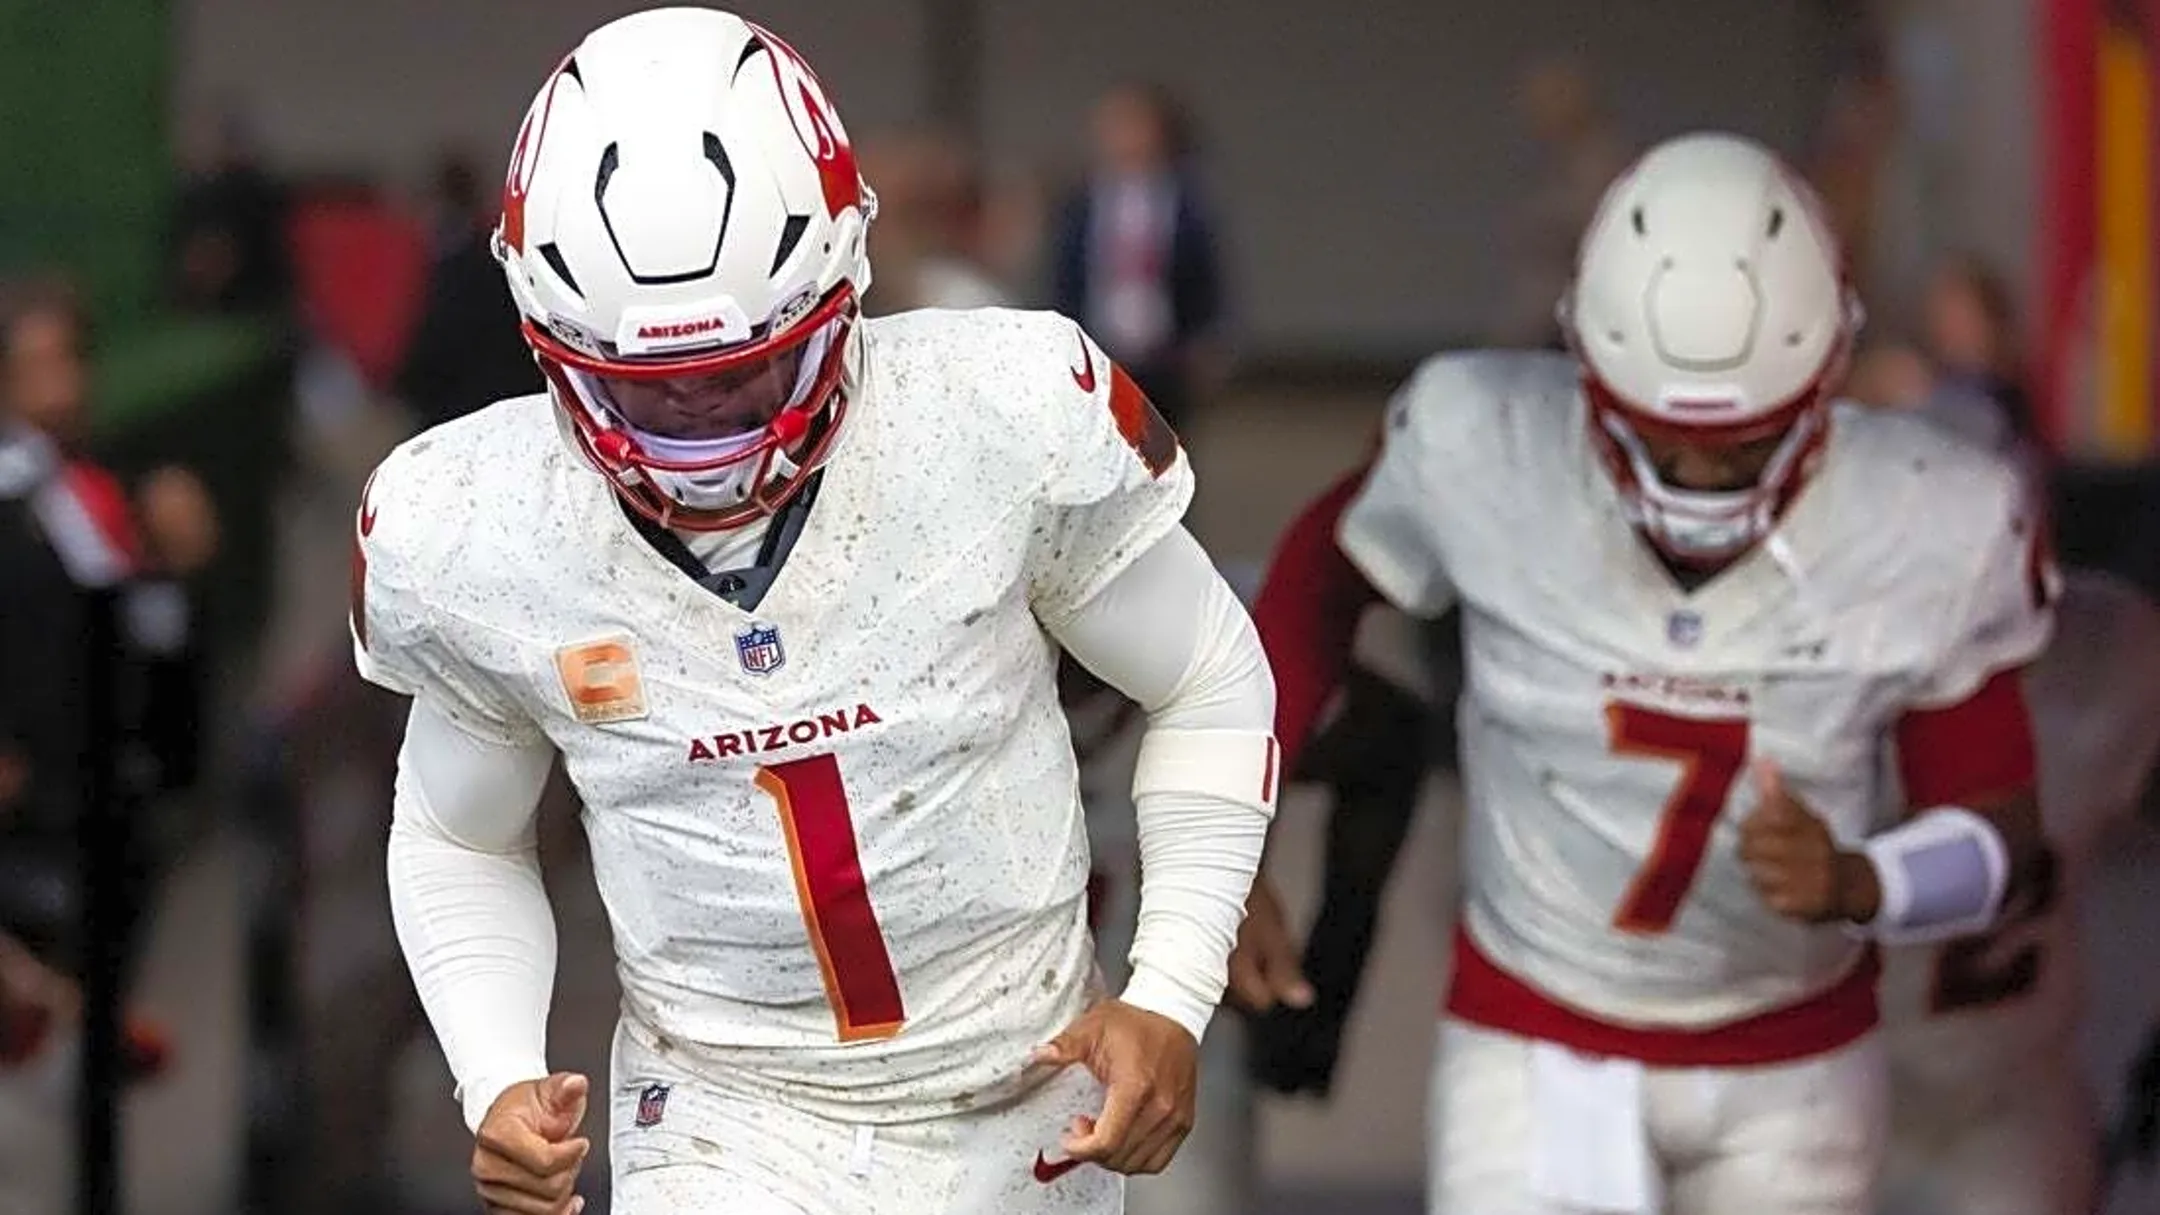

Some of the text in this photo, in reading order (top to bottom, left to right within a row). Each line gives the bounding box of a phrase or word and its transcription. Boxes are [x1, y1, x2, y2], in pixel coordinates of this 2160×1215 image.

[637, 316, 725, 339] ARIZONA
[747, 645, 778, 667] NFL
[688, 703, 882, 762] ARIZONA
[1606, 700, 1750, 935] 7
[753, 752, 906, 1044] 1
